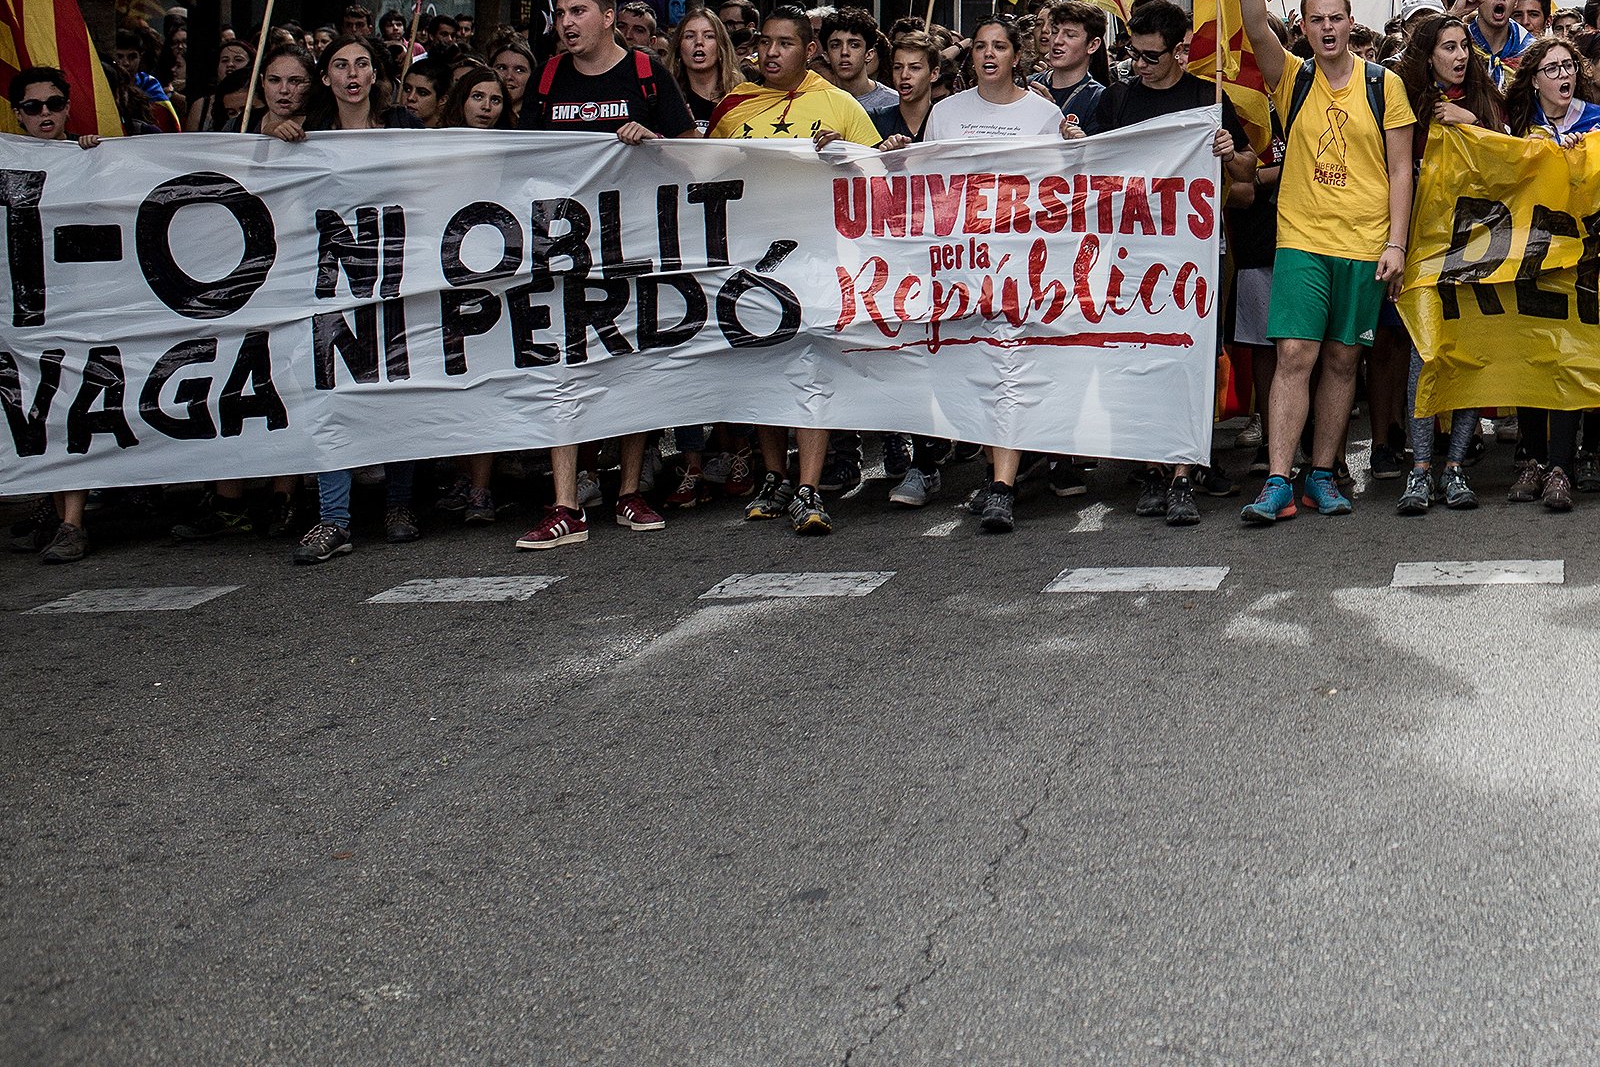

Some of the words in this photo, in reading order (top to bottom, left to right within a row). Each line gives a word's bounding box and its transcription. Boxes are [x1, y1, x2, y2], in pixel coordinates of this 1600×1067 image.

[832, 172, 1216, 241] UNIVERSITATS
[1314, 168, 1347, 180] PRESOS
[314, 204, 406, 300] NI
[440, 178, 744, 288] OBLIT
[835, 232, 1216, 355] República
[929, 240, 965, 275] per
[968, 236, 991, 271] la
[311, 295, 411, 391] NI
[438, 238, 802, 376] PERDÓ
[0, 330, 289, 458] VAGA
